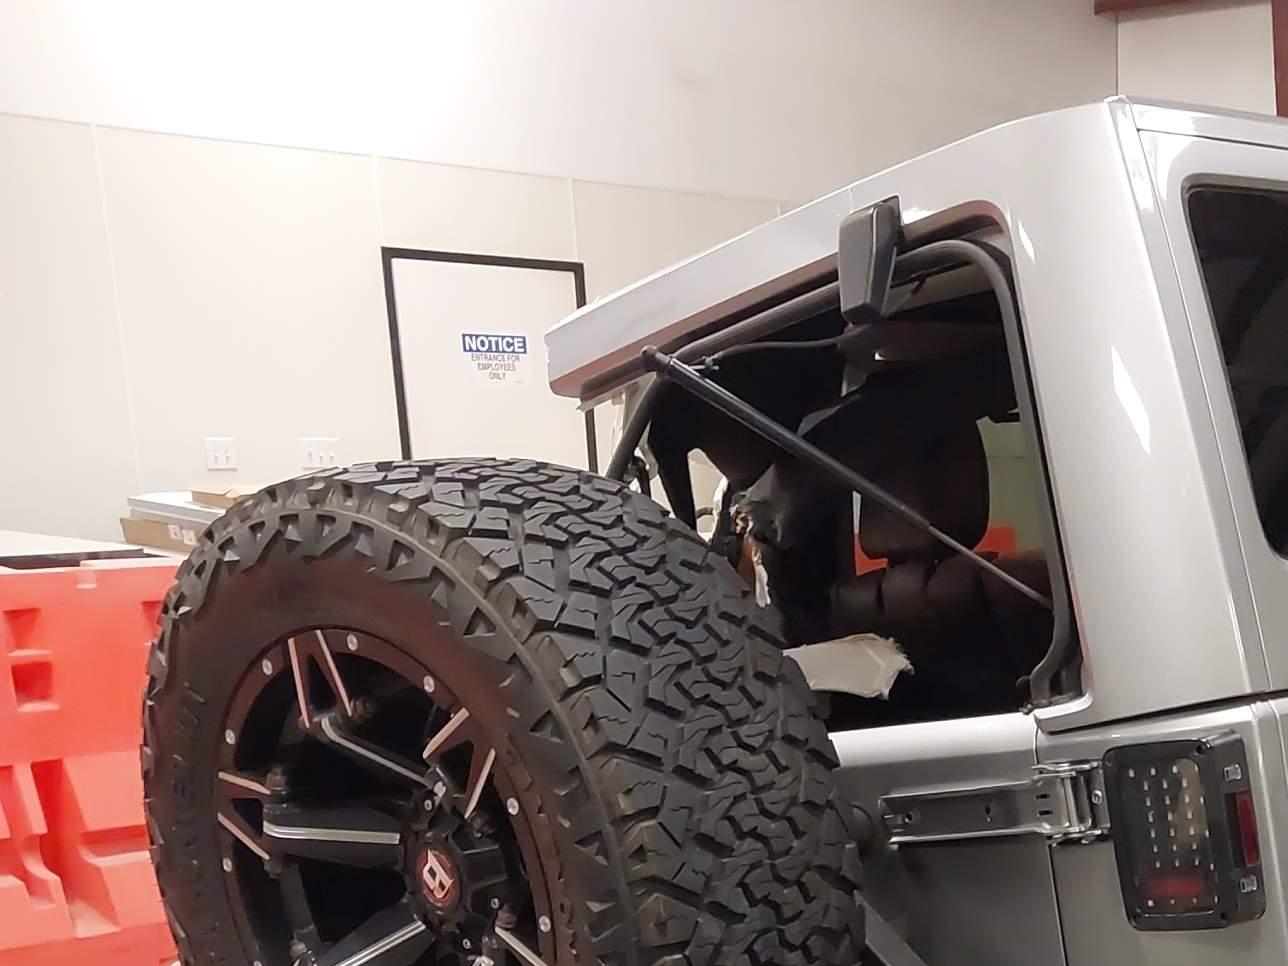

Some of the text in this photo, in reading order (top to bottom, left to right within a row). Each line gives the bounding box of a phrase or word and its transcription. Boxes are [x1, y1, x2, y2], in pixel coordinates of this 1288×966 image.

[464, 336, 525, 353] NOTICE
[471, 353, 520, 362] ENTRANCE FOR
[477, 362, 516, 371] EMPLOYEES
[489, 372, 506, 380] ONLY
